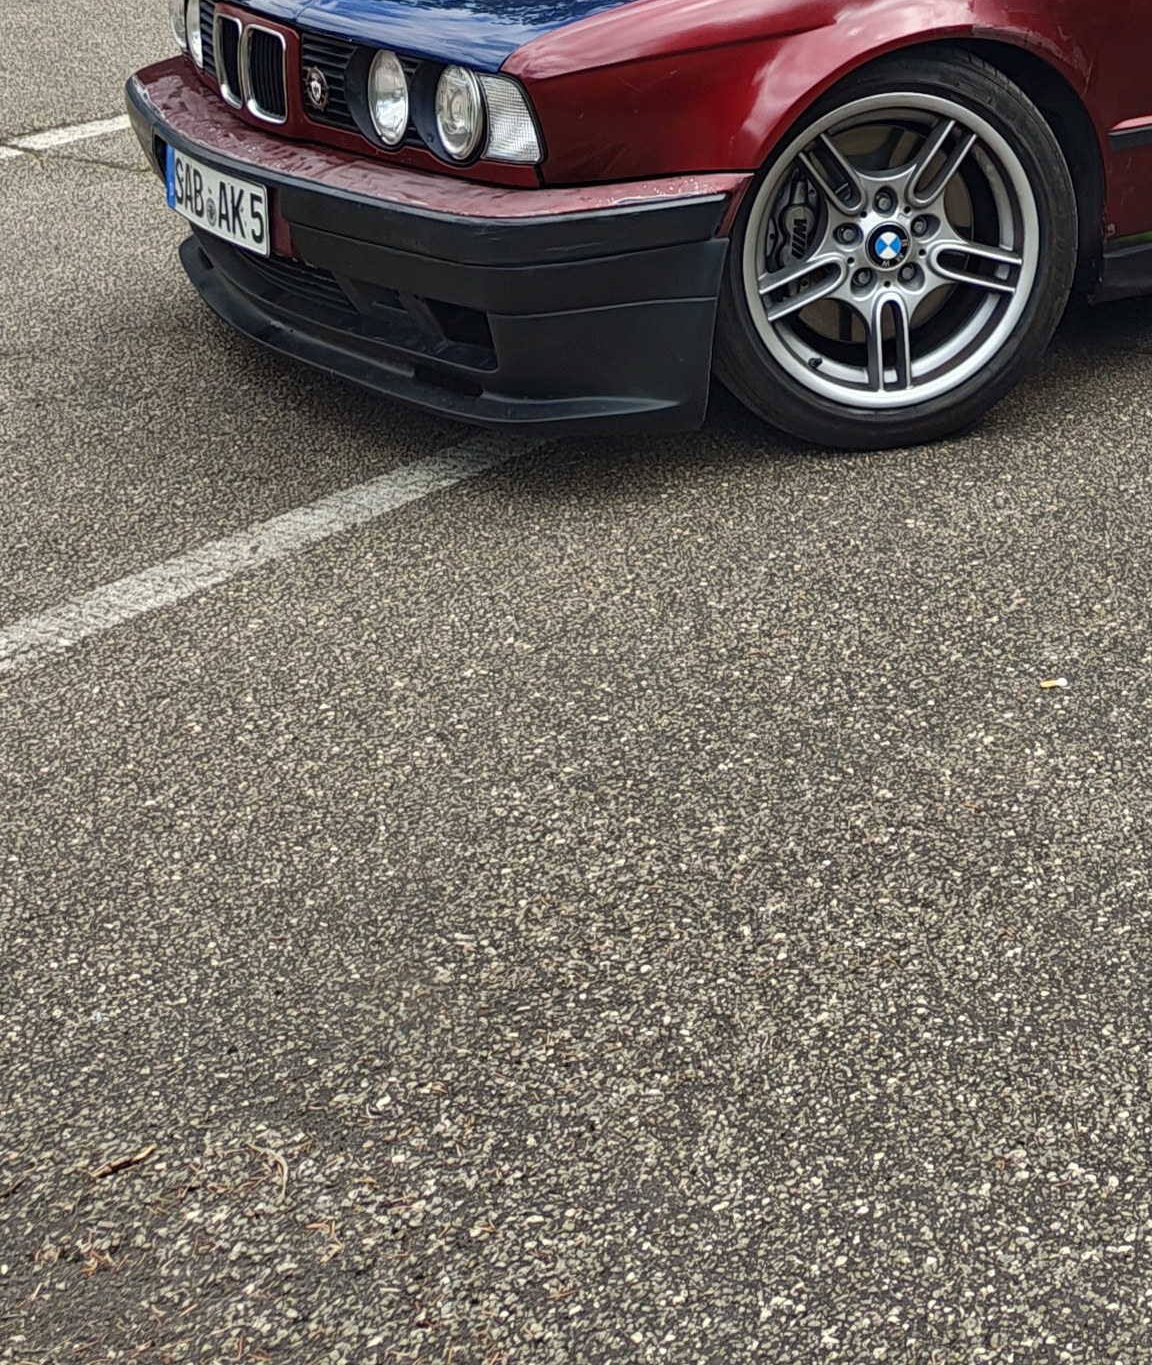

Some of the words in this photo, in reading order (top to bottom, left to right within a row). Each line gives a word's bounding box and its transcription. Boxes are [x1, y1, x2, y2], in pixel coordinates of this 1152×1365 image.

[175, 156, 205, 219] SAB
[218, 180, 247, 240] AK
[249, 192, 265, 245] 5
